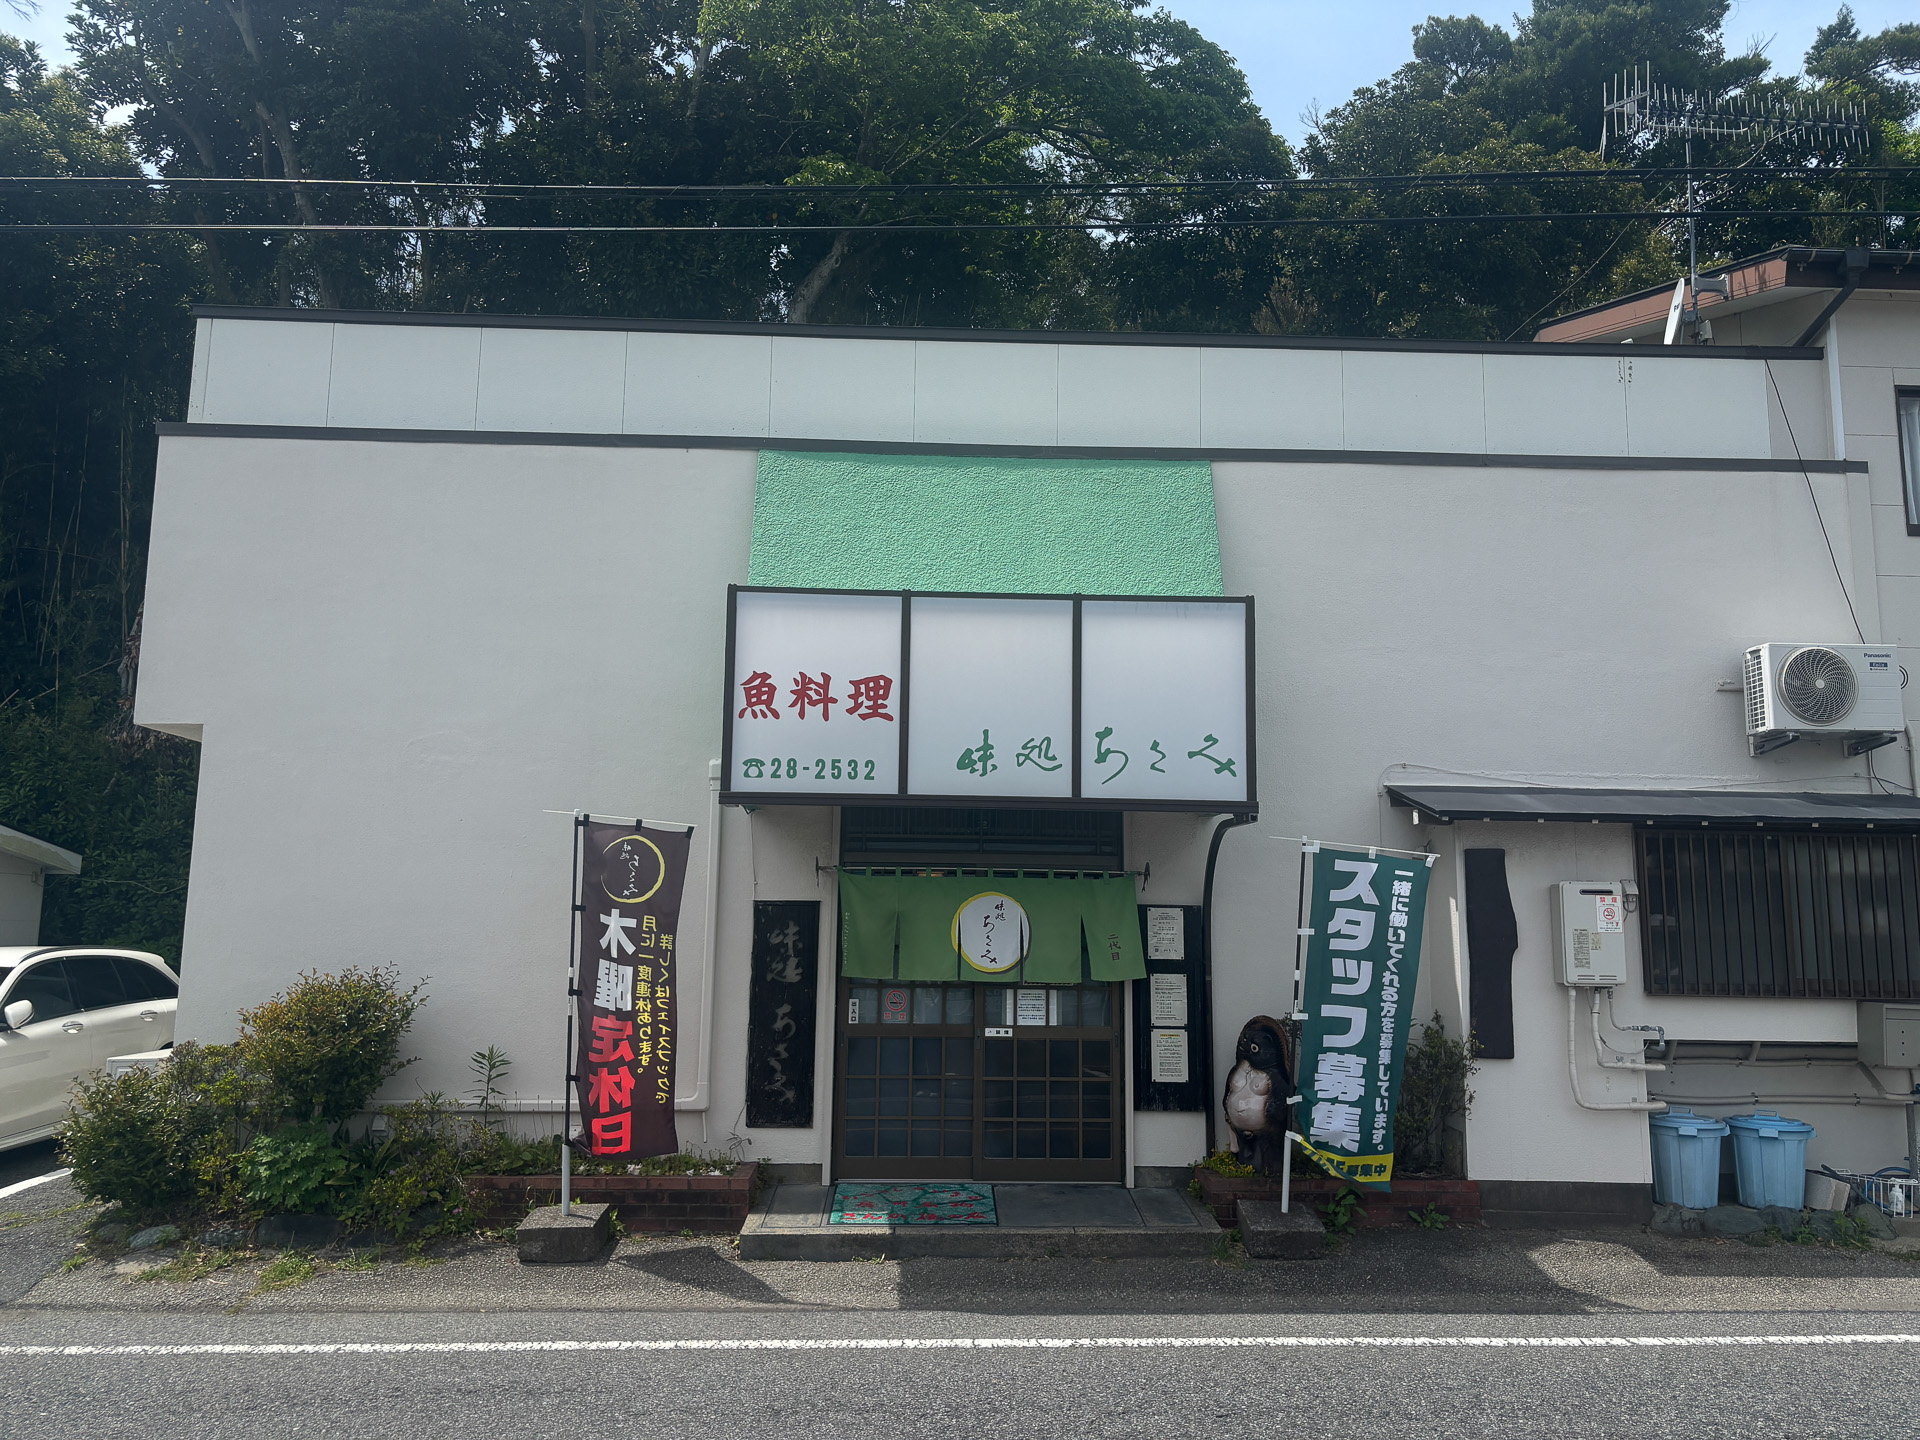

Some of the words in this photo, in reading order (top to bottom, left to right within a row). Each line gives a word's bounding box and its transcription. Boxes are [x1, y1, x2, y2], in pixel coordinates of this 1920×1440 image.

[738, 670, 894, 722] 魚料理
[770, 757, 876, 781] 28-2532
[956, 728, 1063, 778] 味処
[1107, 933, 1121, 961] 二代目
[1310, 859, 1380, 1152] スタッフ募集
[1372, 868, 1414, 1151] 一緒に働いてくれる方を募集しています。
